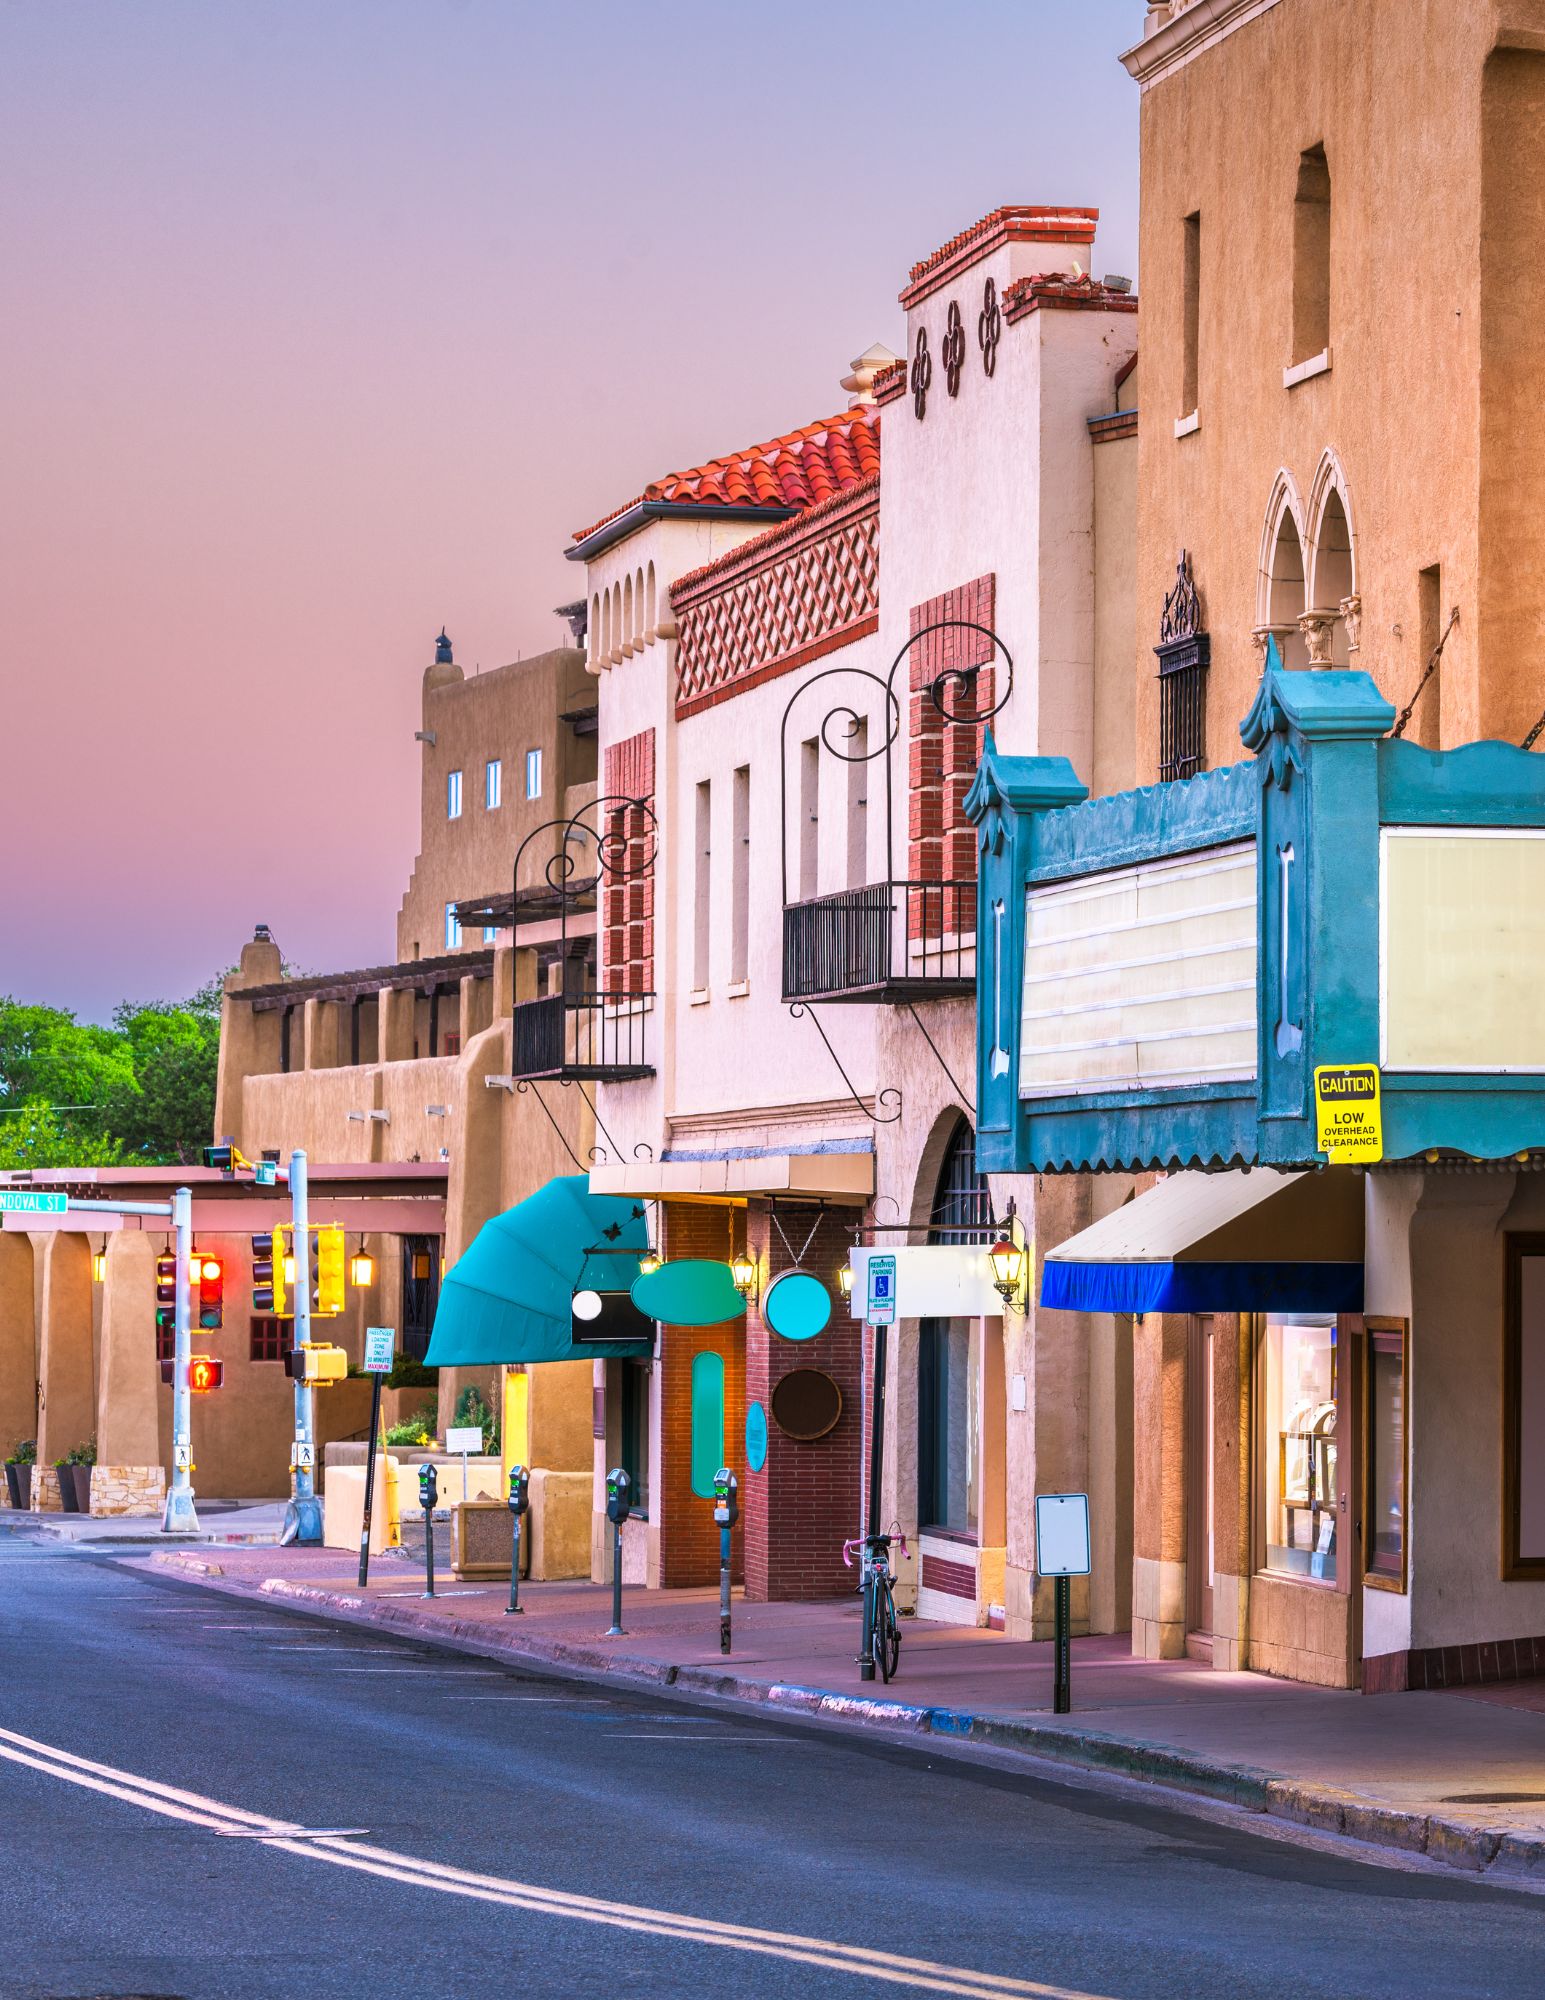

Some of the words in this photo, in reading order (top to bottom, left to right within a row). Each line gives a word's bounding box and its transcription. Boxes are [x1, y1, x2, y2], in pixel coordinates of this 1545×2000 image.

[1321, 1076, 1374, 1093] CAUTION
[1334, 1112, 1365, 1125] LOW
[1324, 1126, 1375, 1136] OVERHEAD
[1321, 1137, 1378, 1147] CLEARANCE
[47, 1195, 60, 1211] ST
